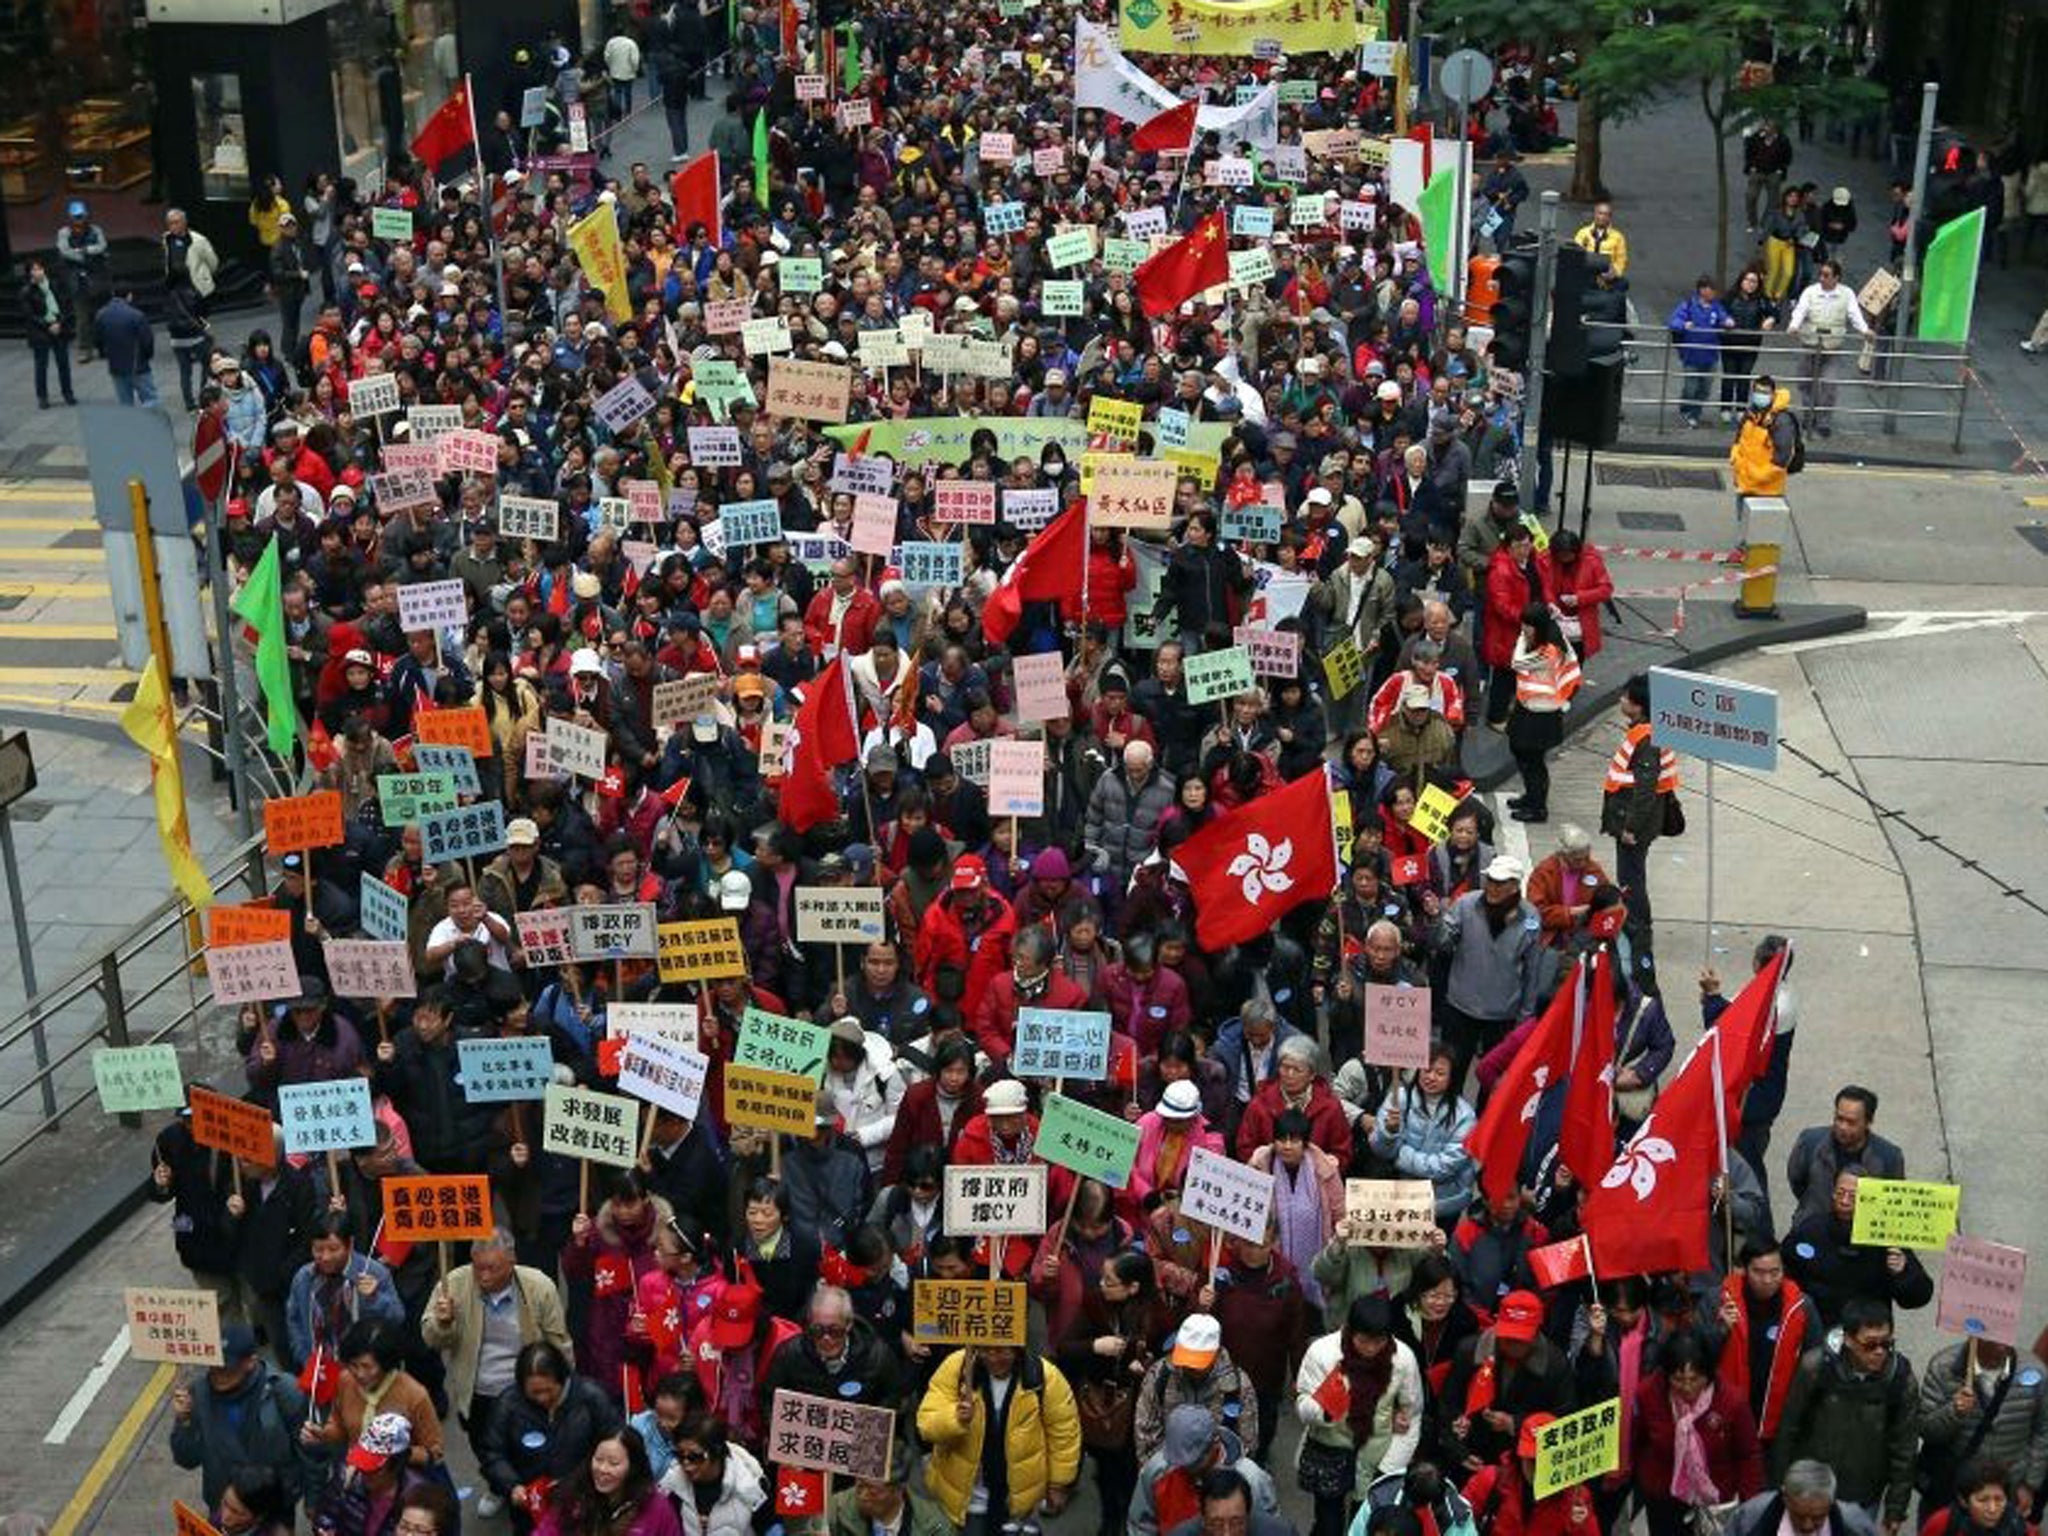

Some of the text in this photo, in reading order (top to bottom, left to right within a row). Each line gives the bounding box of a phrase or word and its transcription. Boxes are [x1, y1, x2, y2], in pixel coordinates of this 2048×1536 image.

[1098, 495, 1167, 516] 黃大仙區
[1691, 689, 1737, 713] C 區
[1658, 711, 1770, 747] 九龍社團聯會
[582, 912, 642, 931] 撐政府
[594, 934, 632, 949] 撐CY
[1023, 1022, 1105, 1047] 團結一心
[294, 1101, 360, 1121] 發展經濟
[563, 1098, 622, 1127] 求發展
[550, 1124, 631, 1158] 改善民生
[962, 1177, 1030, 1198] 撐政府
[973, 1203, 1017, 1223] 撐CY
[936, 1286, 1014, 1311] 迎元旦
[937, 1312, 1015, 1339] 新希望
[780, 1400, 856, 1435] 求穩定
[1543, 1406, 1616, 1450] 支持政府
[777, 1431, 851, 1466] 求發展
